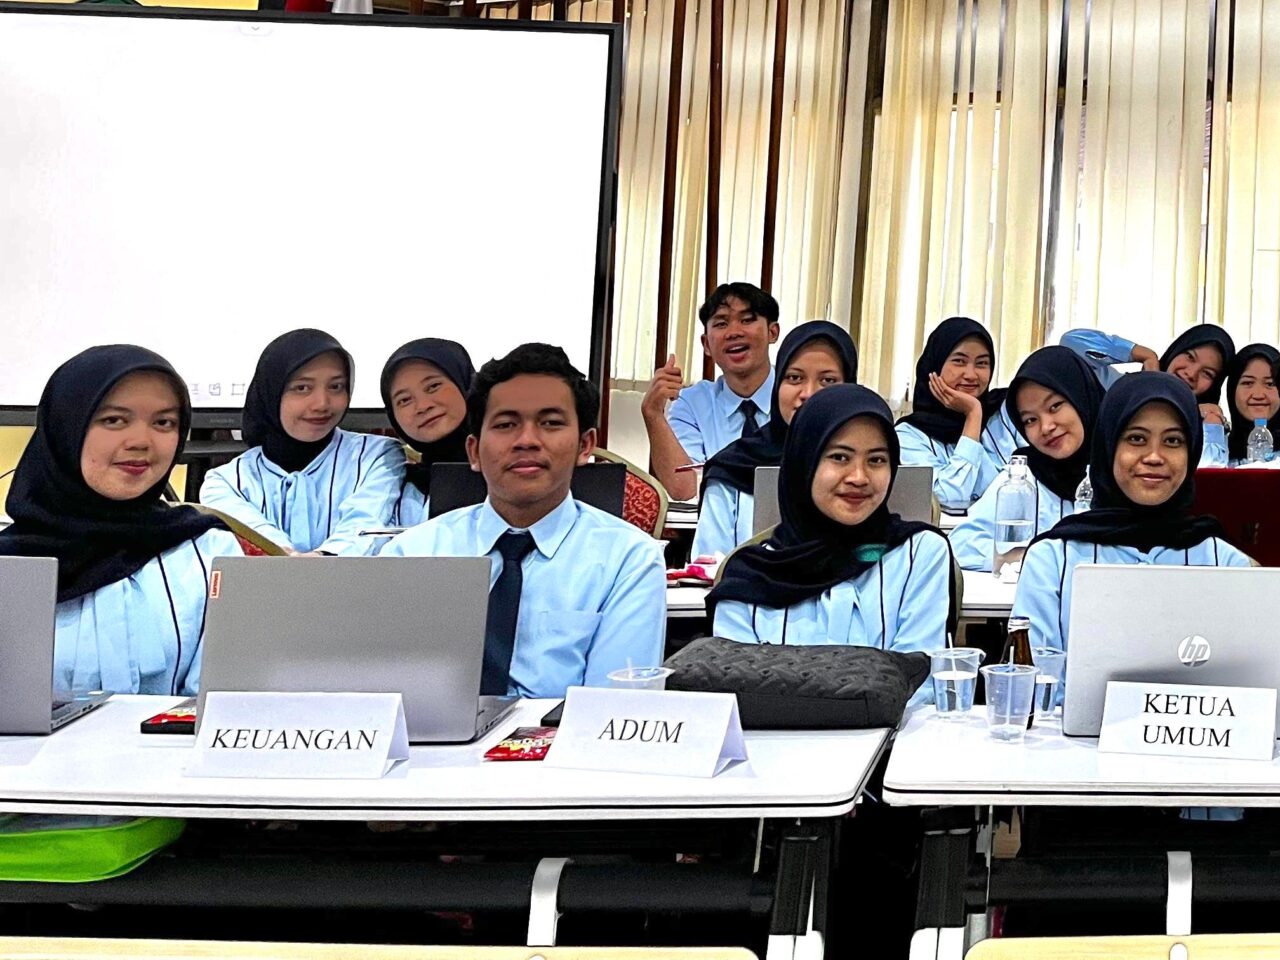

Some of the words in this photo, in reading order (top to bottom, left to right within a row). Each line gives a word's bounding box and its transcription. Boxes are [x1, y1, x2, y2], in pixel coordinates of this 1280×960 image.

[1181, 636, 1208, 667] hp
[1143, 693, 1236, 717] KETUA
[211, 729, 378, 751] KEUANGAN
[598, 719, 683, 743] ADUM
[1143, 724, 1231, 747] UMUM
